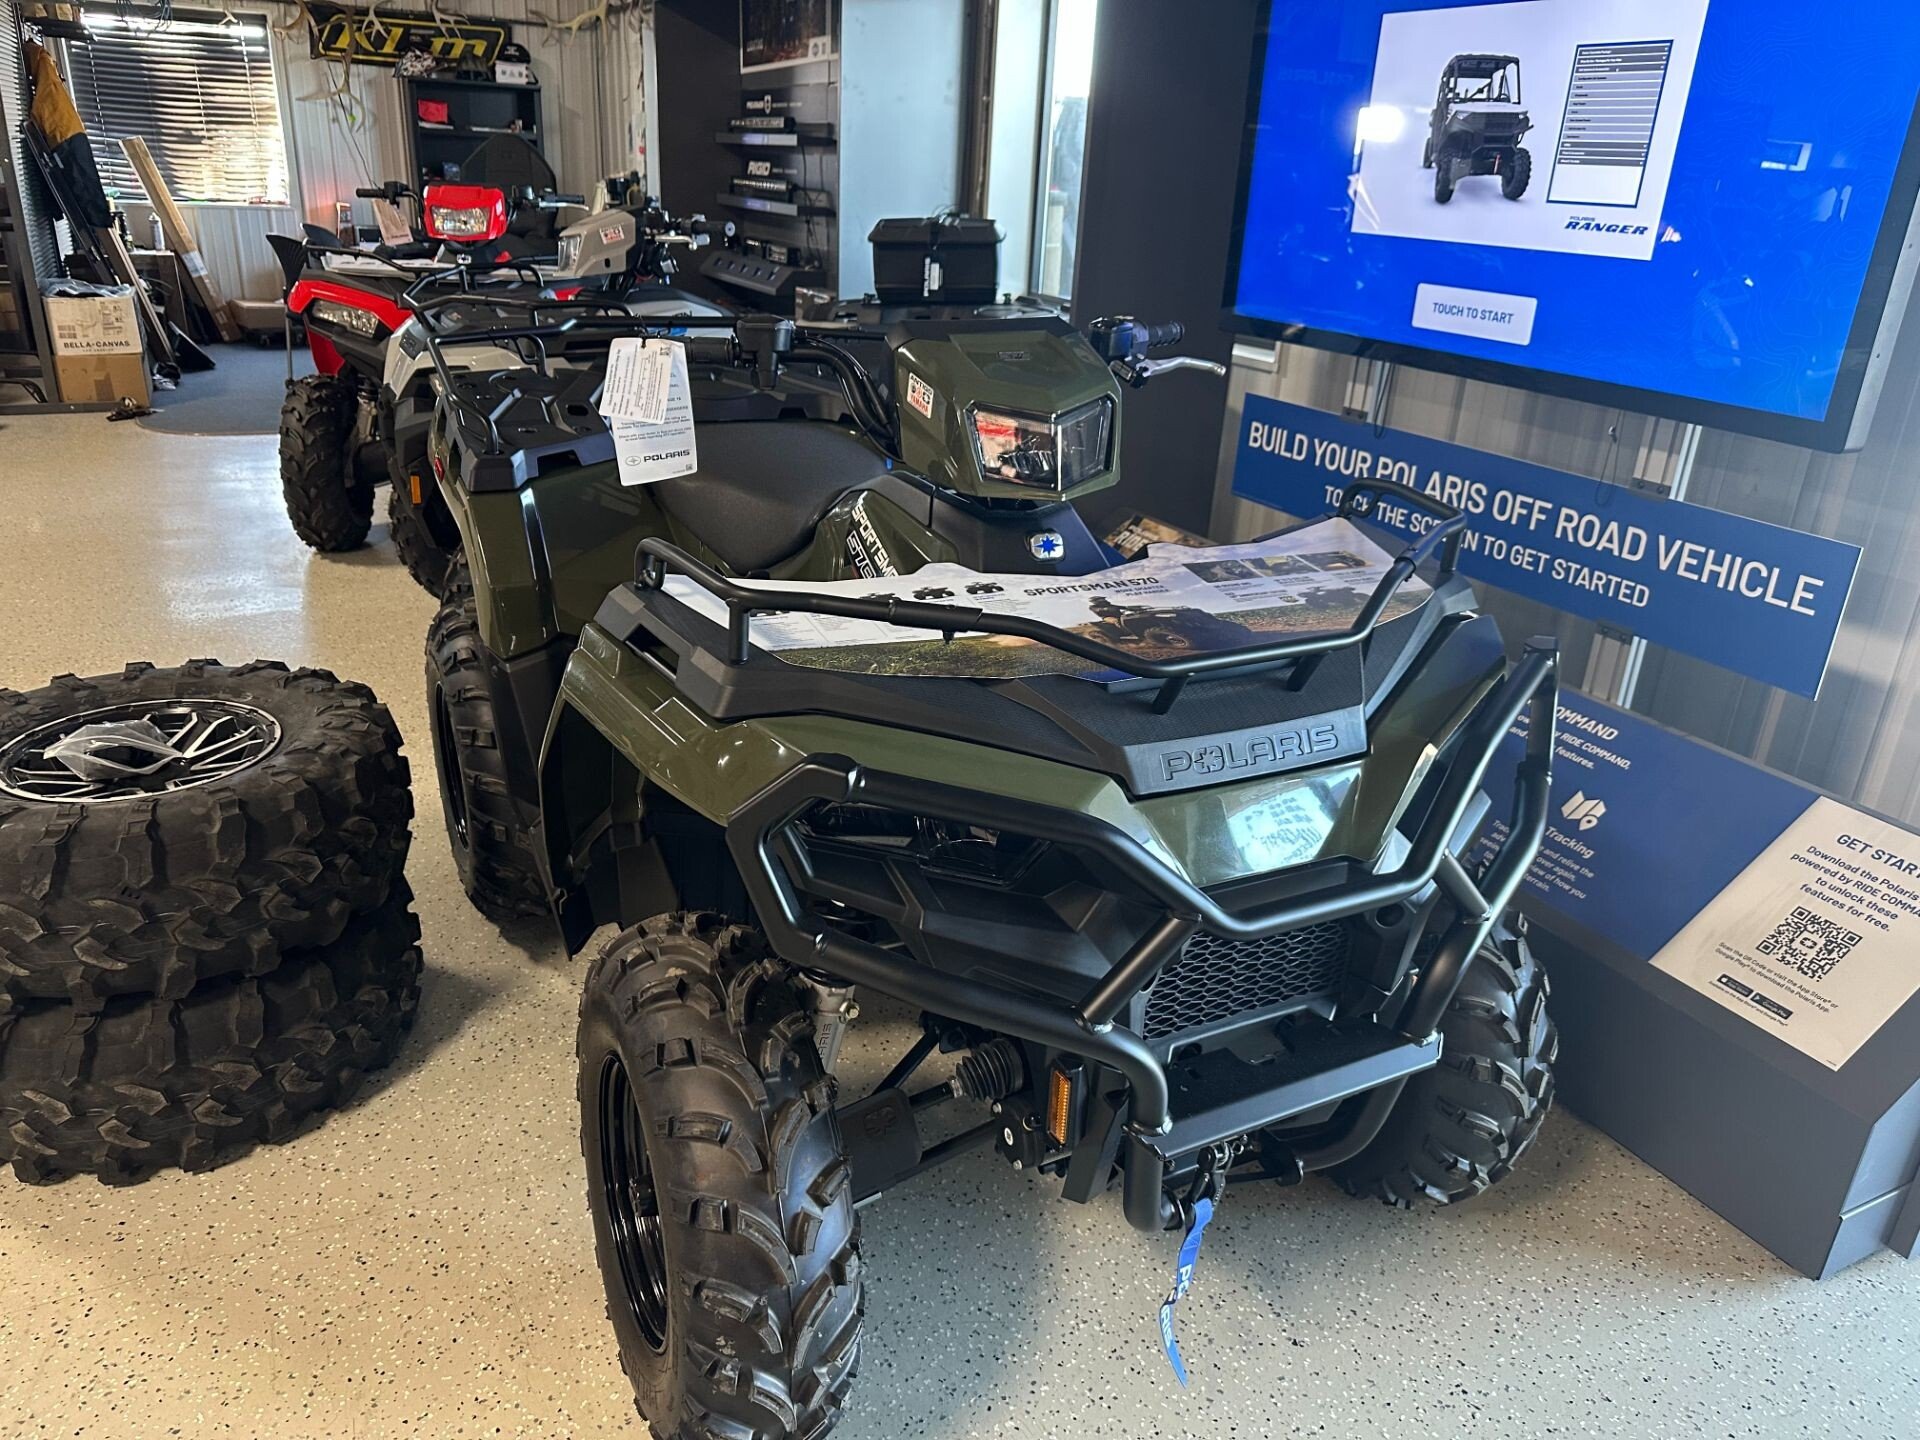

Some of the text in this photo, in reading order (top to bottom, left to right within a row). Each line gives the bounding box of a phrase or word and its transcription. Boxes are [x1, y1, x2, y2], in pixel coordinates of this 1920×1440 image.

[1564, 221, 1649, 235] RANGER
[1433, 302, 1515, 325] TOUCH TO START
[643, 449, 691, 463] POLARIS
[1248, 420, 1308, 461] BUILD
[1313, 438, 1372, 478] YOUR
[1492, 490, 1553, 530] OFF
[1555, 507, 1648, 561] ROAD
[1658, 534, 1825, 616] VEHICLE
[1324, 485, 1650, 608] TOC THE SCN TO GET STARTED
[1023, 576, 1160, 597] SPORTSMAN 570
[1555, 706, 1619, 740] OMMAND
[1160, 724, 1339, 781] POLARIS
[1555, 746, 1595, 769] features.
[1560, 732, 1584, 748] RIDE
[1581, 742, 1632, 770] COMMAND,
[1545, 826, 1595, 859] Tracking
[1836, 834, 1873, 854] GET
[1536, 856, 1555, 869] over
[1579, 867, 1595, 878] the
[1790, 853, 1840, 878] powered
[1838, 873, 1855, 885] by
[1852, 880, 1882, 898] RIDE
[1806, 846, 1920, 901] Download the Polaris
[1544, 873, 1557, 881] of
[1552, 877, 1573, 891] how
[1568, 887, 1587, 899] you
[1815, 876, 1899, 920] to unlock these
[1800, 883, 1890, 932] features for free.
[1751, 959, 1767, 970] Code
[1795, 991, 1816, 1006] Polaris
[1160, 1263, 1193, 1349] PORIS
